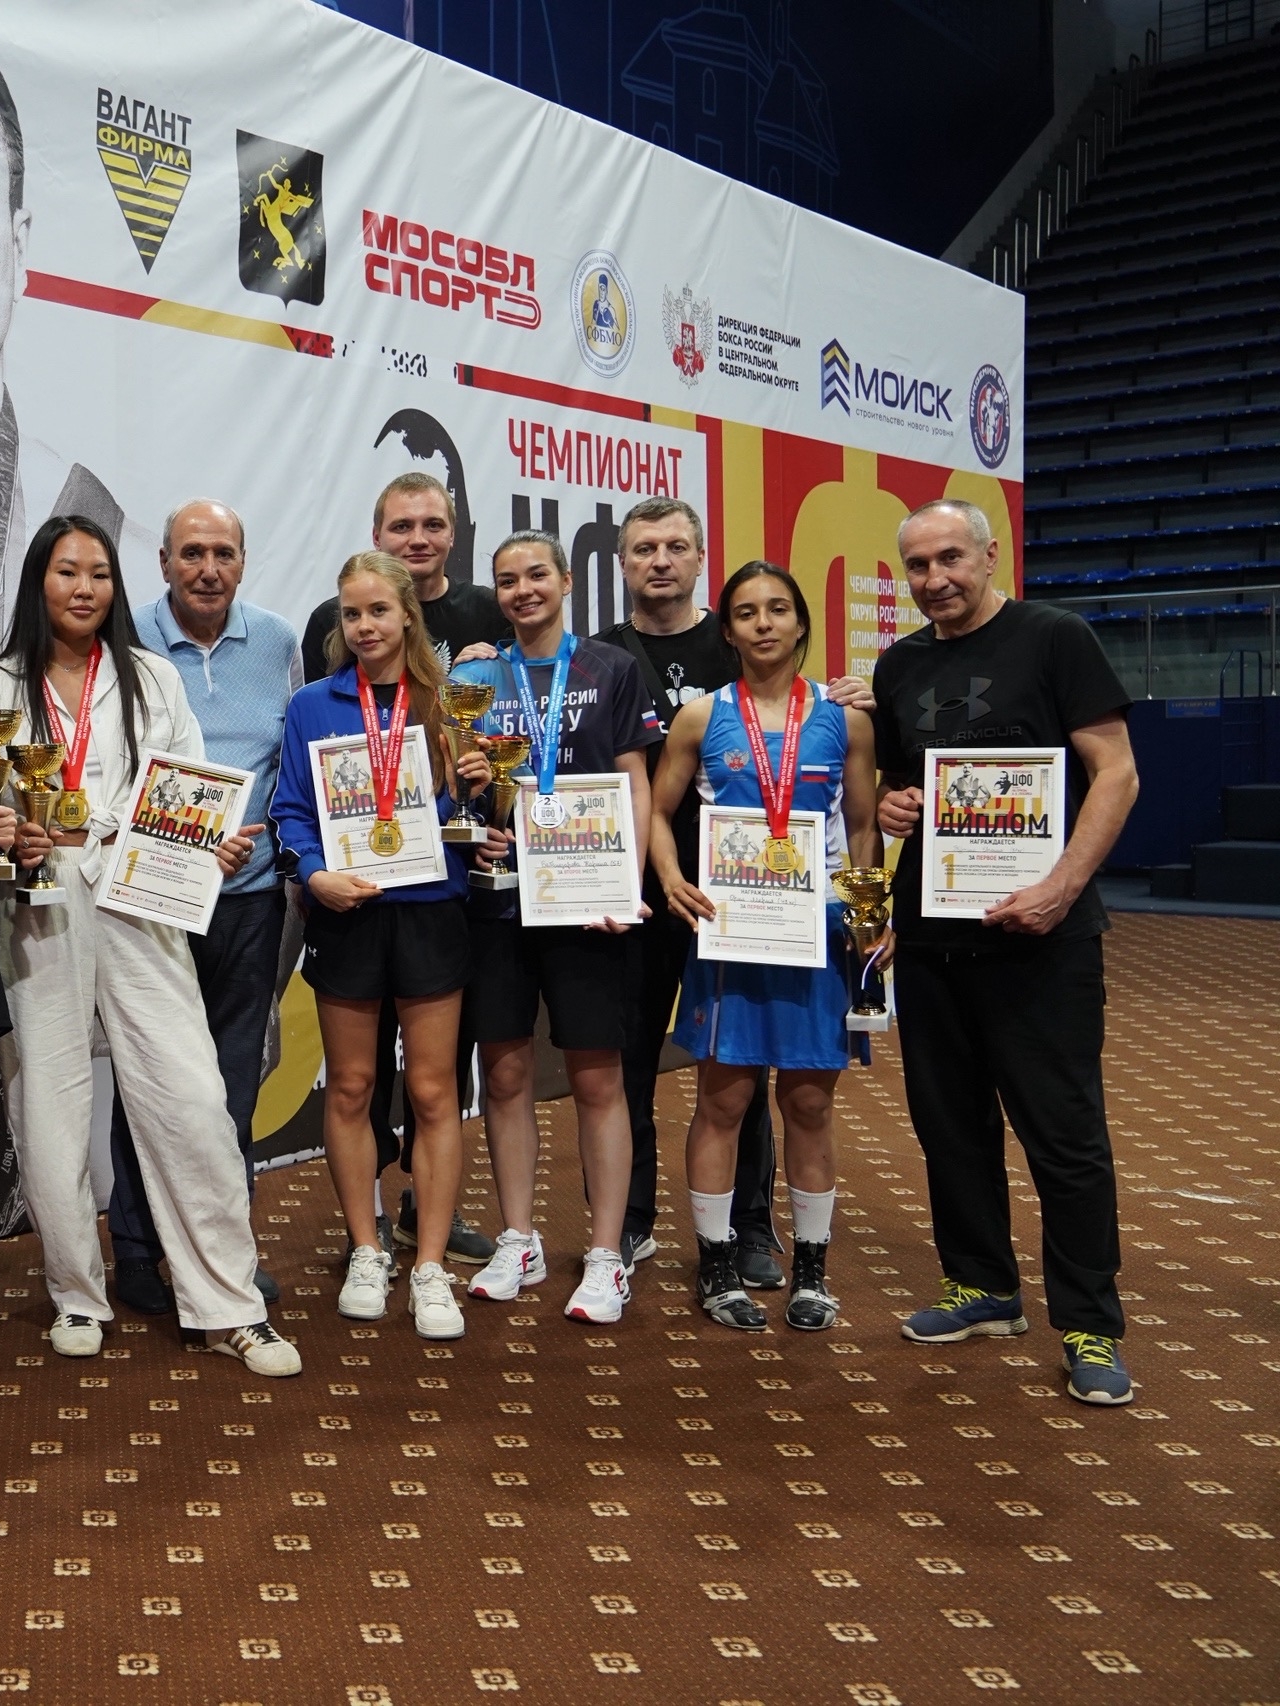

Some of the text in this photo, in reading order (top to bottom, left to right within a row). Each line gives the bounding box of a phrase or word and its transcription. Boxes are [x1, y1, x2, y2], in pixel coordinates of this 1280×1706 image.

[96, 87, 192, 147] ВАГАНТ
[97, 124, 191, 171] ФИРМА
[362, 208, 535, 292] МОСОБЛ
[364, 255, 510, 323] СПОРТ
[586, 325, 622, 347] СФБМО
[718, 315, 801, 348] ДИРЕКЦИЯ ФЕДЕРАЦИИ
[718, 331, 773, 355] БОКСА РОССИИ
[718, 346, 779, 372] В ЦЕНТРАЛЬНОМ
[718, 362, 799, 391] ФЕДЕРАЛЬНОМ ОКРУГЕ
[855, 362, 953, 423] МОИСК
[855, 408, 954, 438] строительство нового уровня
[508, 418, 682, 499] ЧЕМПИОНАТ
[850, 575, 896, 597] ЧЕМПИОНАТ
[850, 603, 879, 621] ОКРУГА
[879, 605, 910, 624] РОССИИ
[911, 608, 921, 625] ПО
[541, 688, 598, 710] РССИИ
[489, 714, 500, 726] ПО
[949, 725, 1023, 745] ARMOUR
[760, 753, 768, 767] СРЕДИ
[1012, 774, 1033, 786] ЦФО
[205, 787, 224, 802] ЦФО
[544, 797, 551, 805] 2
[587, 797, 605, 808] ЦФО
[131, 810, 225, 849] ДИПЛОМ
[936, 813, 1049, 837] ДИПЛОМ
[155, 840, 192, 854] НАГРАЖДАЕТСЯ
[528, 831, 622, 855] ДИПЛОМ
[156, 857, 173, 866] ПЕРВОЕ
[173, 861, 188, 870] МЕСТО
[535, 867, 555, 901] 2
[710, 864, 811, 892] ДИПЛОМ
[741, 889, 782, 897] НАГРАЖДАЕТСЯ
